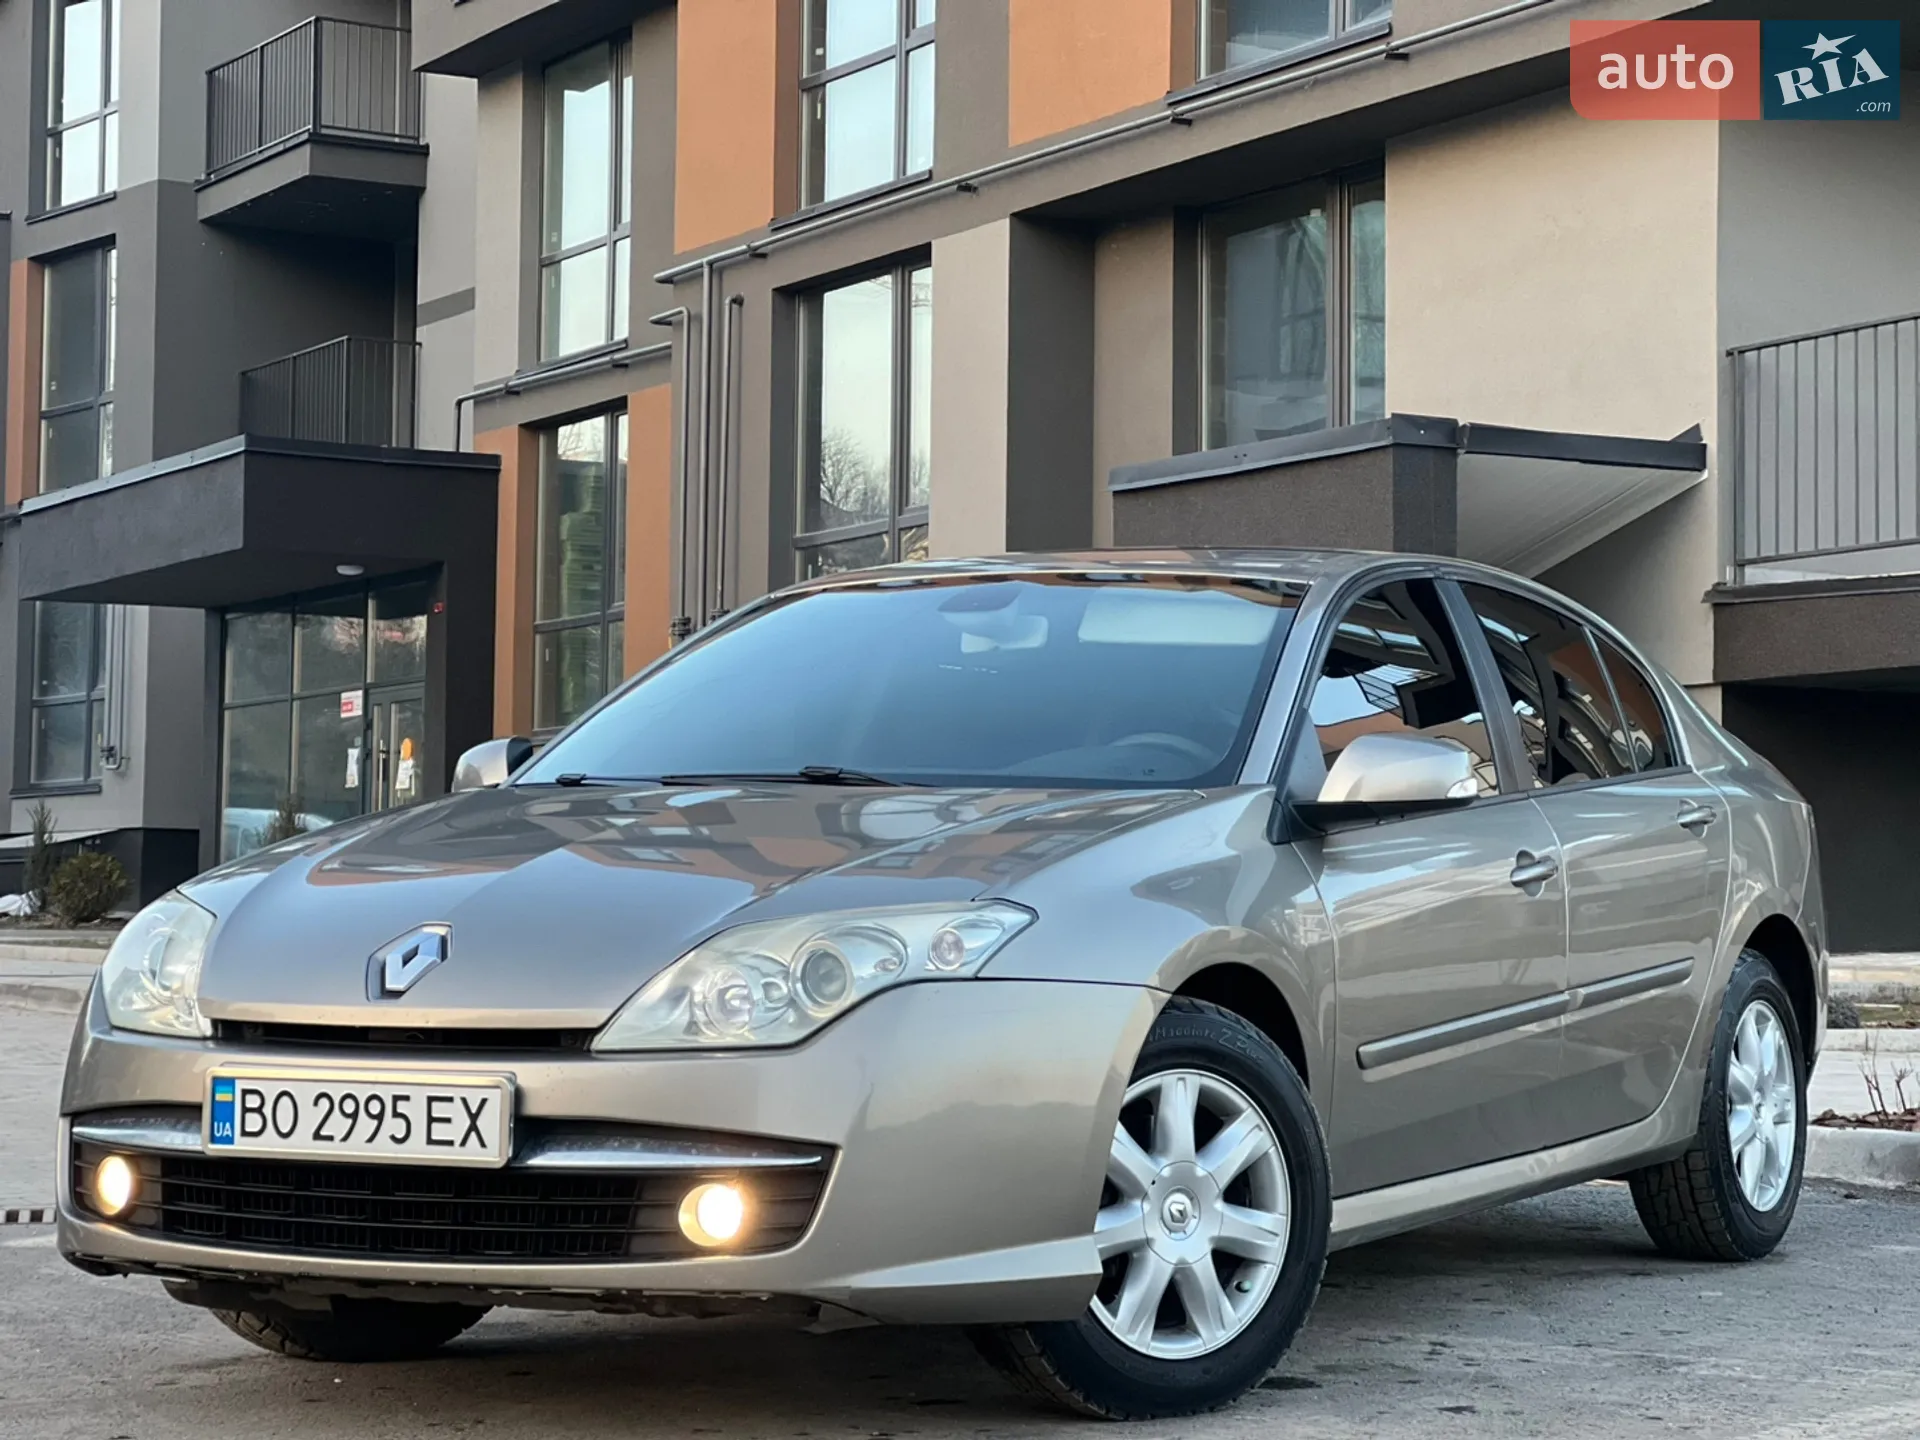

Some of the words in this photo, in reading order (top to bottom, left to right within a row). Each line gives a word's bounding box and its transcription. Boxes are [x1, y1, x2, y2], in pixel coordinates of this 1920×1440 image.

[213, 1121, 233, 1138] UA
[240, 1088, 299, 1139] BO
[312, 1092, 412, 1144] 2995
[426, 1095, 489, 1149] EX
